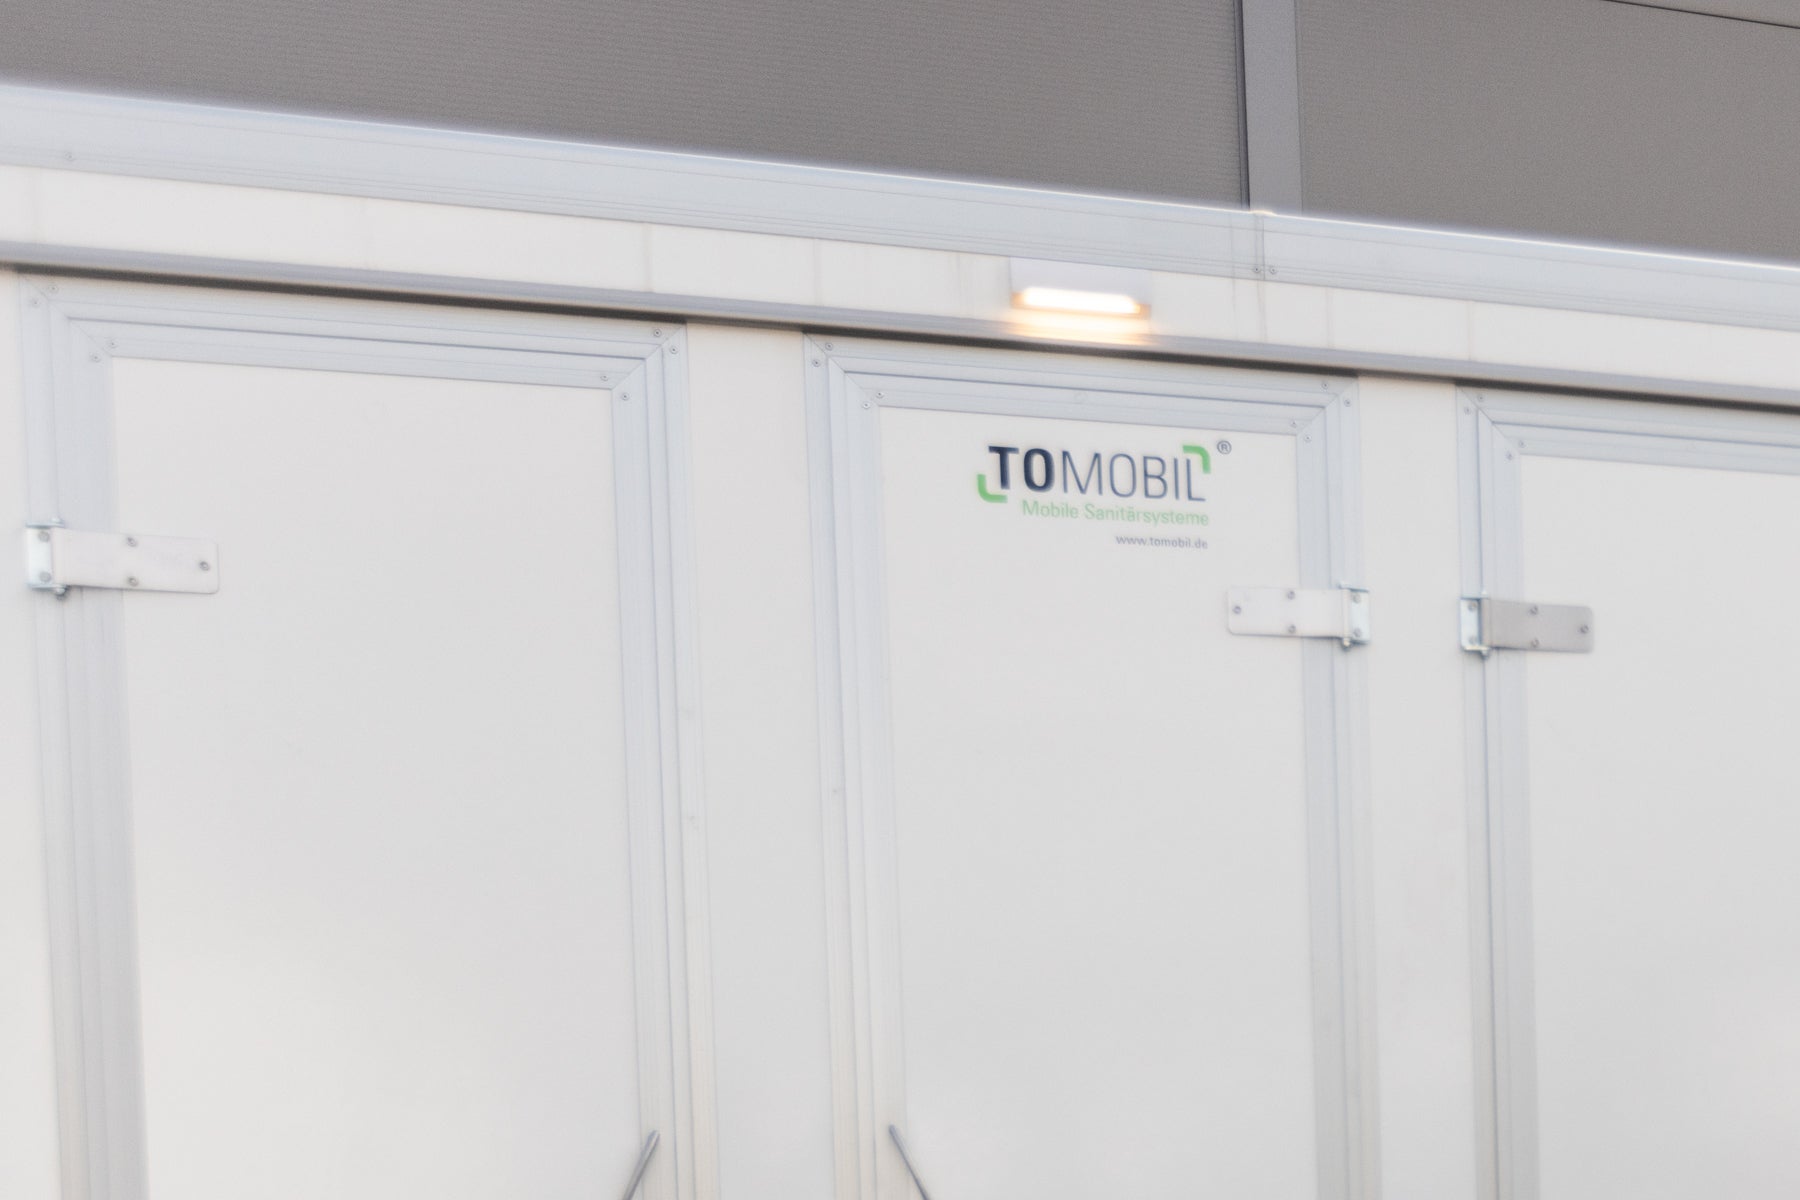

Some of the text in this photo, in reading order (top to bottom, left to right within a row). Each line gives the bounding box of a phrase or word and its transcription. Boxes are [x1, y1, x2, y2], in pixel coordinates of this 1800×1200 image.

[988, 446, 1206, 502] TOMOBIL
[1022, 500, 1209, 526] Mobile Sanitärsysteme
[1115, 534, 1208, 550] www.tomobil.de
